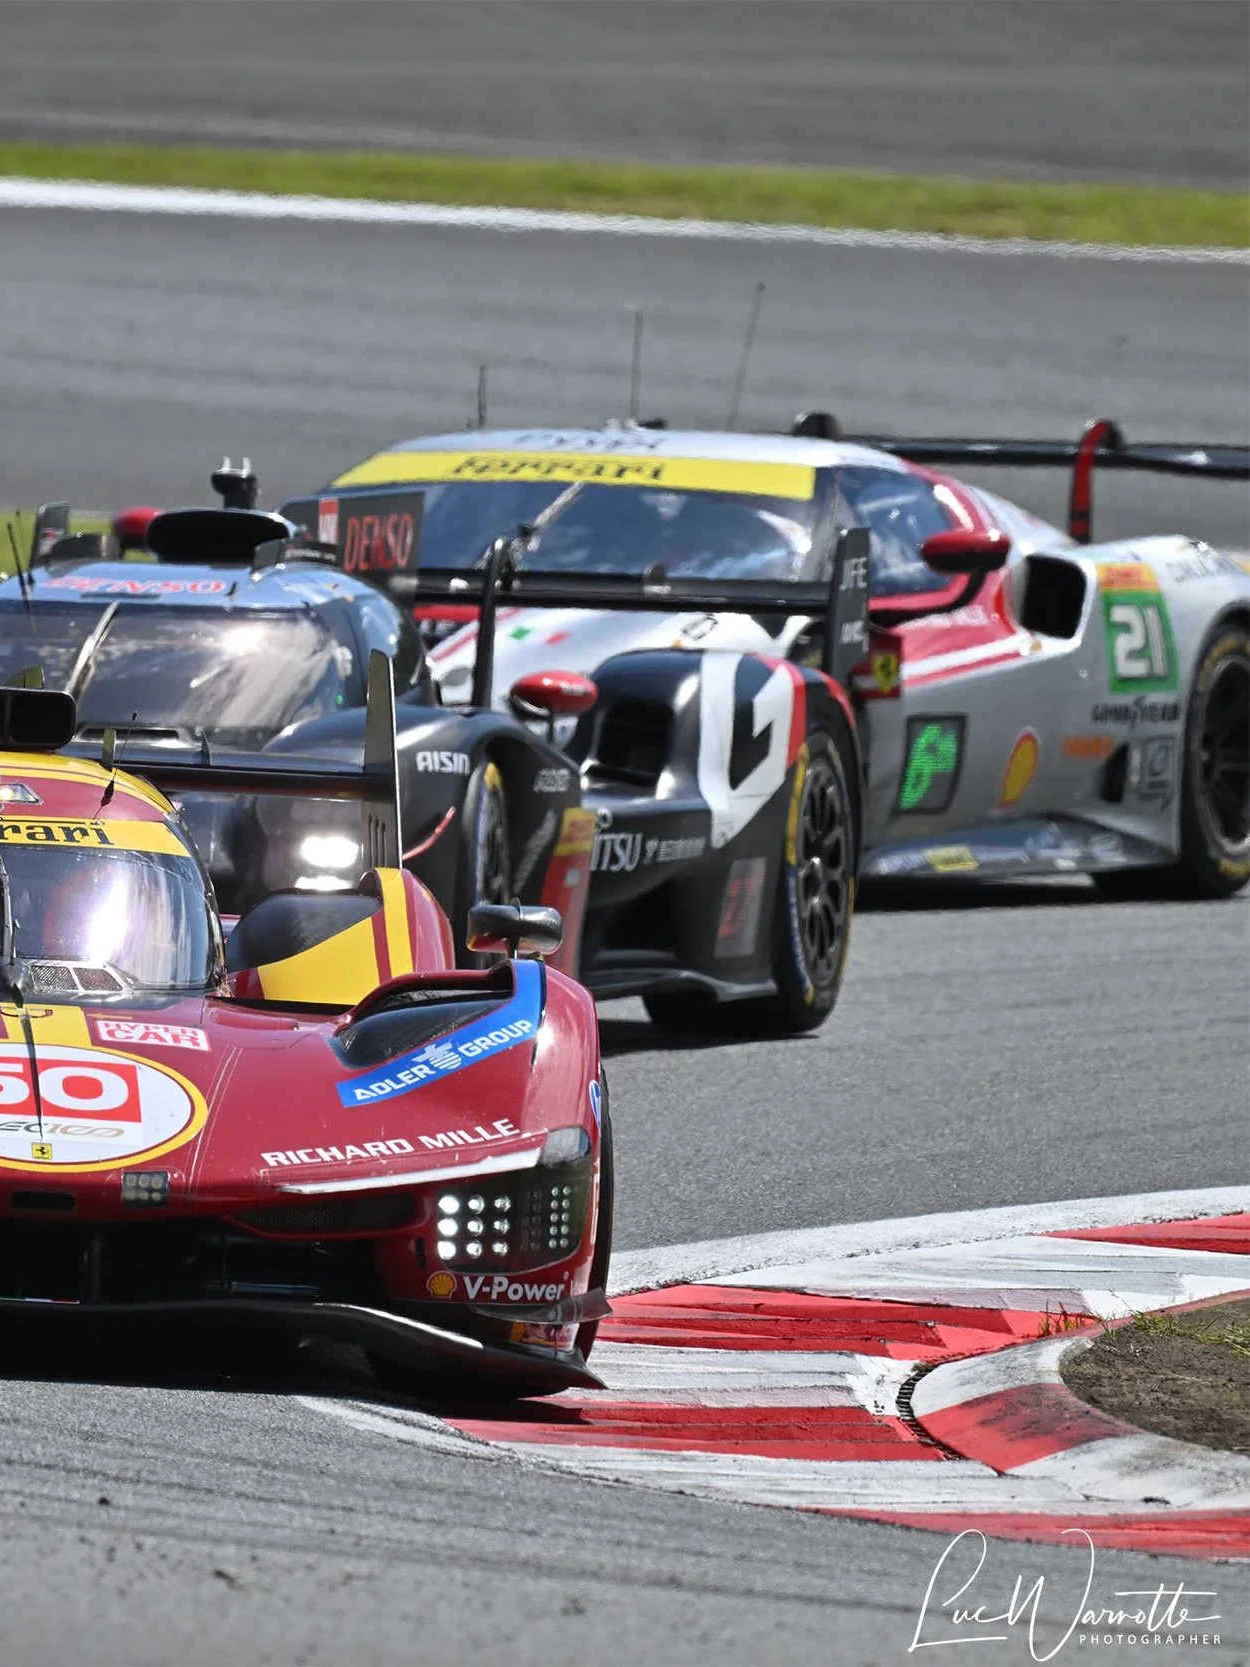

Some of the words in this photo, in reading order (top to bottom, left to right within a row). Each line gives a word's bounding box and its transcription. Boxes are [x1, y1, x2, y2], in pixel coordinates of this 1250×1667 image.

[343, 513, 413, 573] DENSO
[1110, 604, 1170, 680] 21
[415, 751, 471, 775] AISIN
[103, 1022, 199, 1036] HYPER
[106, 1028, 201, 1048] CAR
[352, 1062, 437, 1101] ADLER
[456, 1018, 533, 1058] GROUP
[260, 1137, 415, 1167] RICHARD
[417, 1118, 520, 1150] MILLE
[463, 1275, 566, 1301] V-Power
